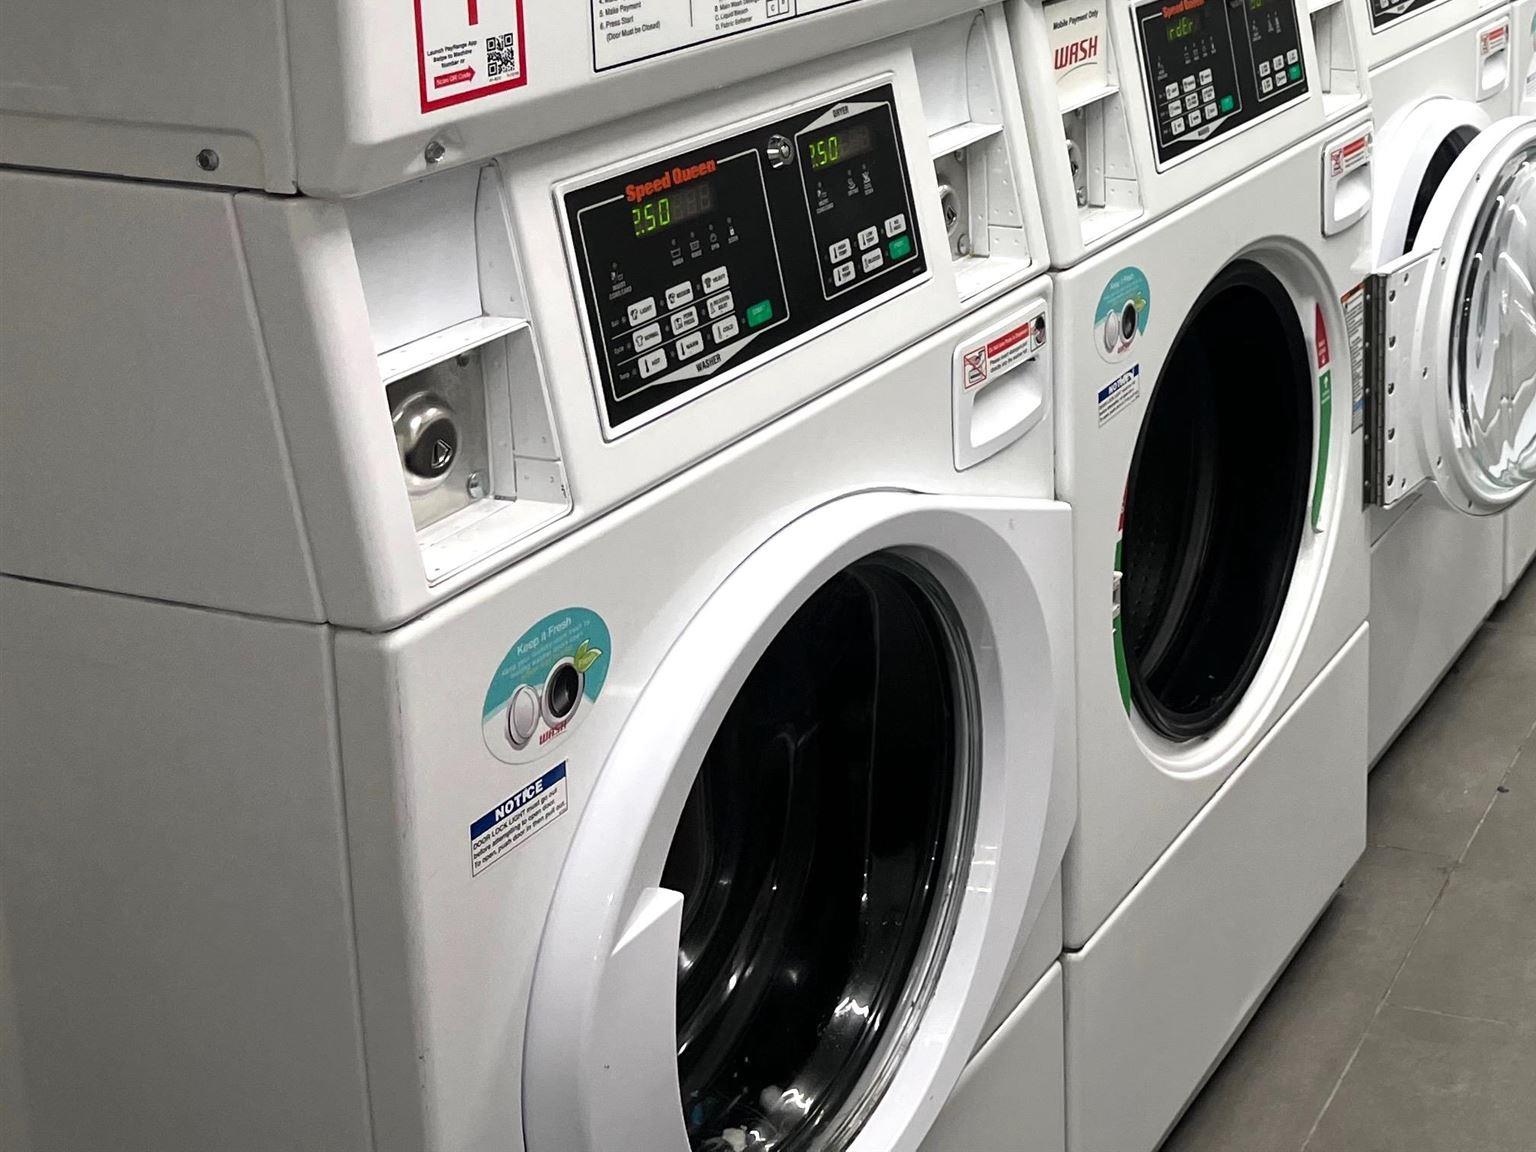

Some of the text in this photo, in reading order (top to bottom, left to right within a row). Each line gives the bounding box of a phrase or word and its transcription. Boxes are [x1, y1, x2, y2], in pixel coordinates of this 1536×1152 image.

[1053, 10, 1098, 30] Mobile Payment Only
[1054, 35, 1098, 70] WASH
[832, 105, 850, 118] DRYER
[625, 159, 717, 203] Speed Queen
[696, 353, 722, 372] WASHER
[517, 637, 540, 656] Keep
[548, 617, 572, 637] Fresh
[540, 720, 568, 745] WASH
[494, 779, 544, 822] NOTICE
[473, 834, 491, 850] DOOR
[492, 822, 508, 837] LOCK
[508, 808, 526, 825] LIGHT
[526, 800, 540, 813] must
[521, 818, 528, 826] to
[528, 809, 542, 821] open
